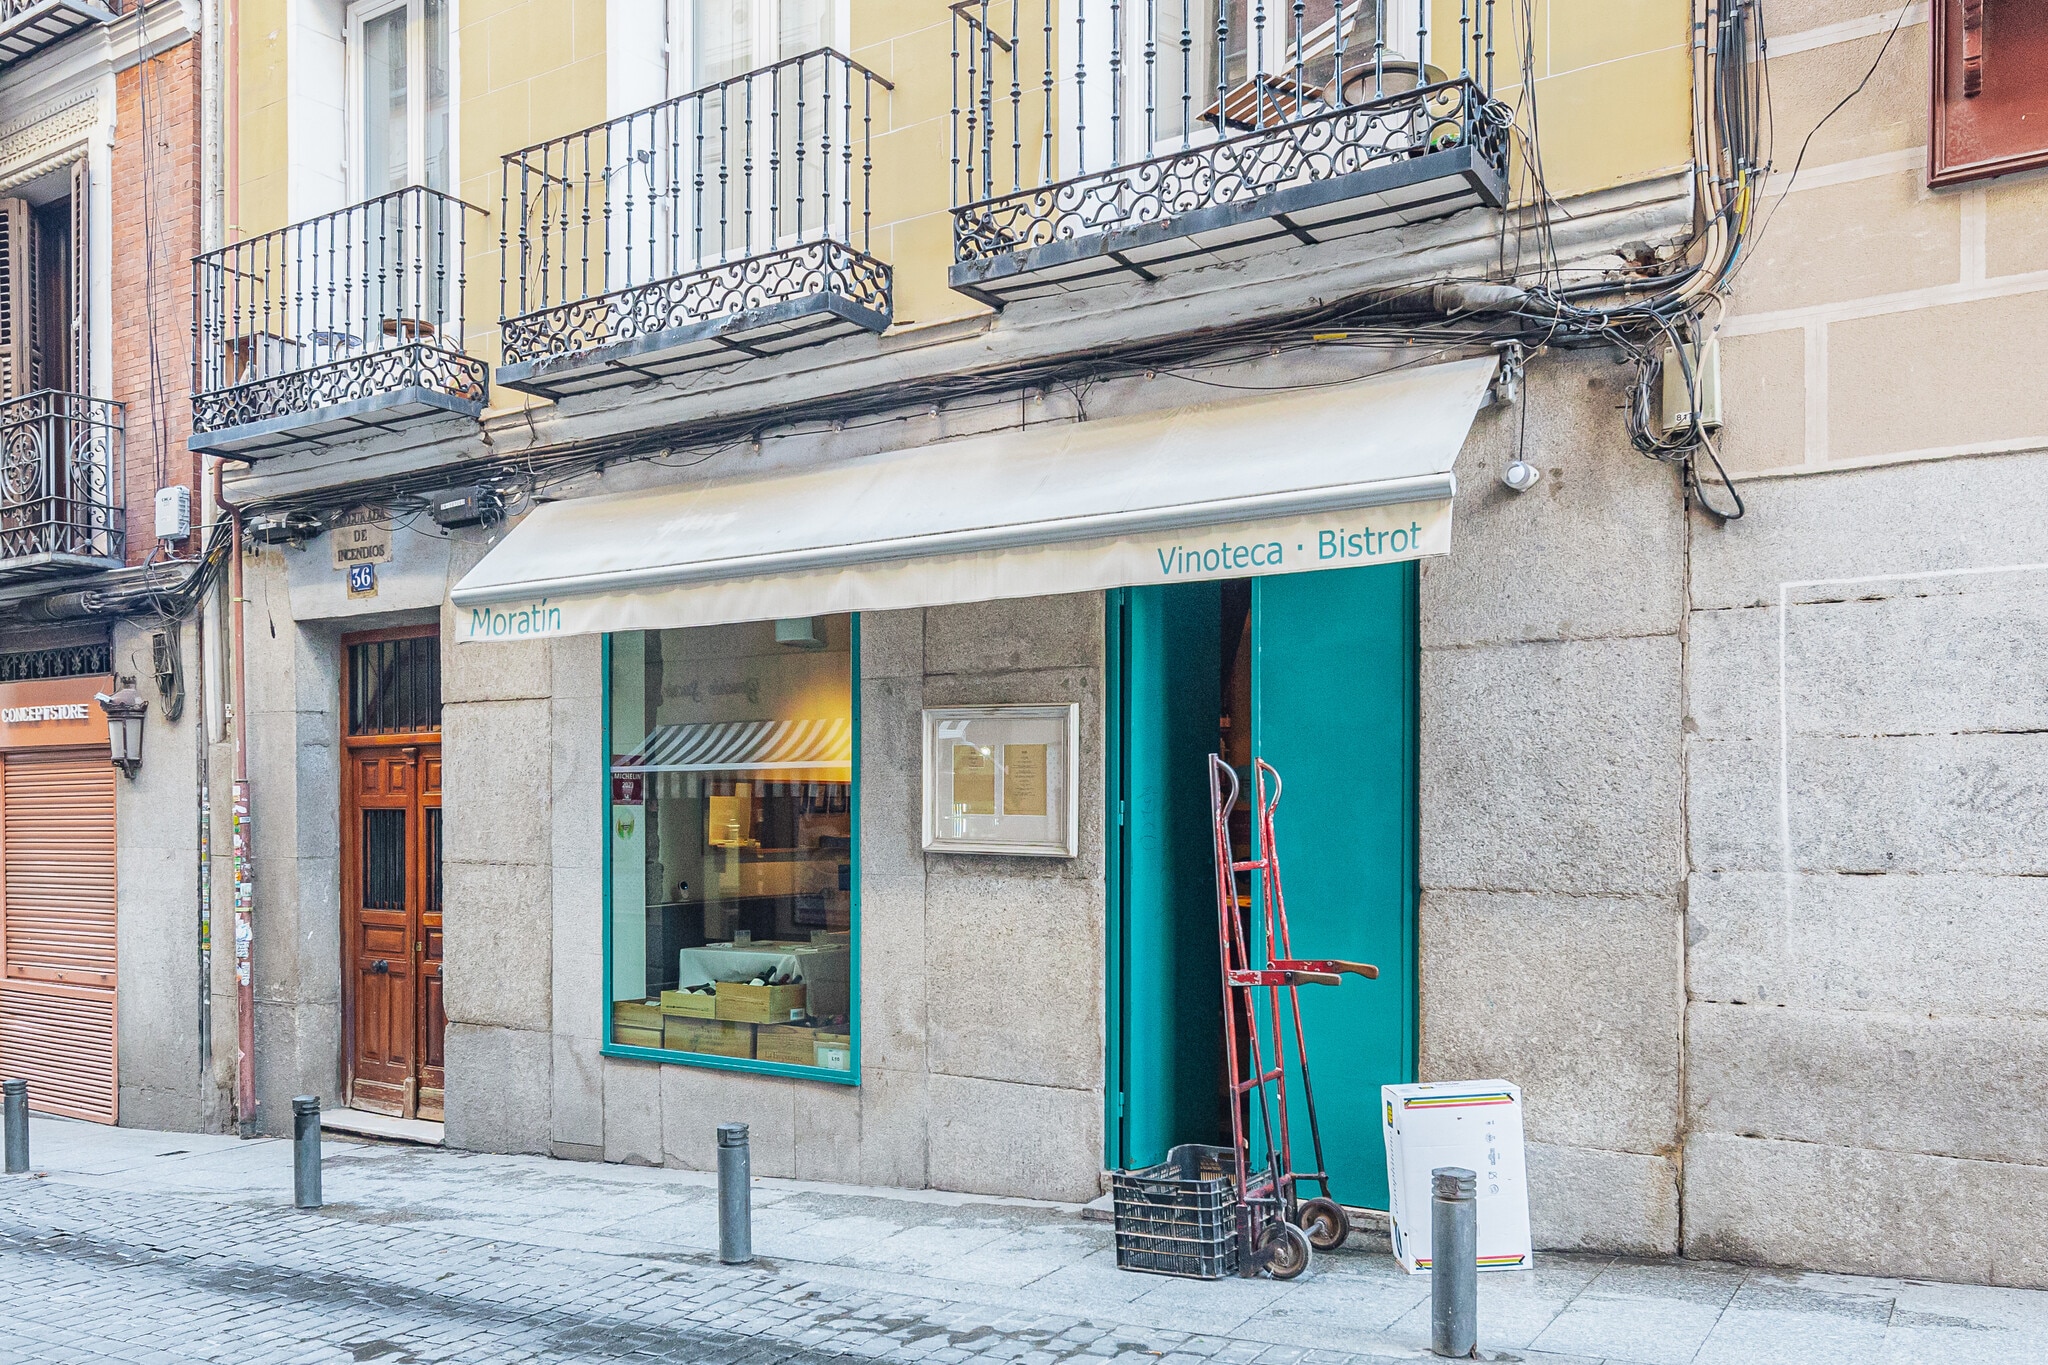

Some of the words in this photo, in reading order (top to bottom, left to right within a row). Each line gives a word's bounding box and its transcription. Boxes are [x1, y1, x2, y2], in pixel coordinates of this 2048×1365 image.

[354, 529, 367, 542] DE
[338, 544, 385, 562] INCENDIOS
[1157, 541, 1283, 575] Vinoteca
[1318, 521, 1422, 560] Bistrot
[352, 566, 371, 587] 36
[470, 598, 561, 636] Moratín
